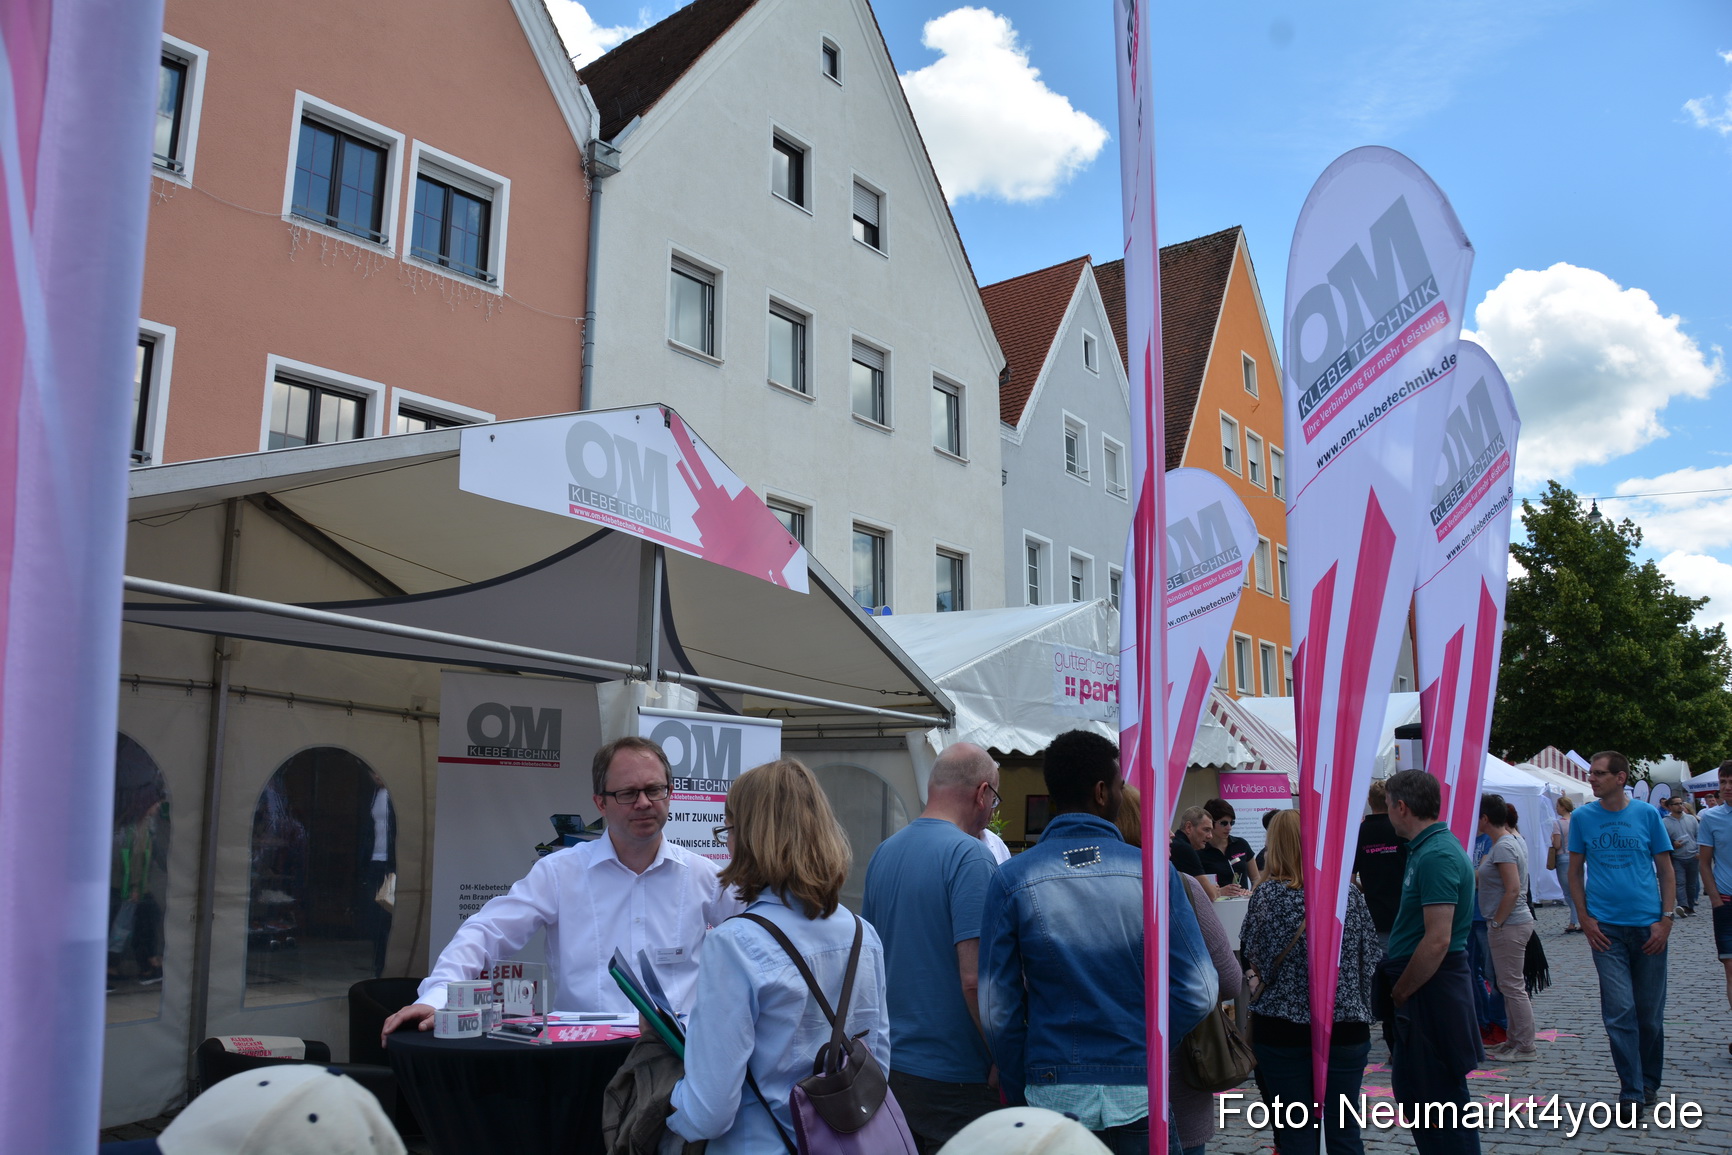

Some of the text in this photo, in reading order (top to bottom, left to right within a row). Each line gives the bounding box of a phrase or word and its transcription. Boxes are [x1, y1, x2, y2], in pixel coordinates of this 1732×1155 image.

[1290, 194, 1434, 392] OM
[1299, 277, 1439, 416] KLEBE TECHNIK
[1306, 309, 1447, 437] Ihre Verbindung für mehr Leistung
[1316, 352, 1457, 469] www.om-klebetechnik.de
[565, 420, 669, 517] OM
[1432, 437, 1505, 523] KLEBE TECHNIK
[1447, 499, 1473, 528] Verbindung
[1489, 457, 1510, 480] Leistung
[571, 486, 671, 532] KLEBE TECHNIK
[574, 508, 645, 534] www.om-klebetechnik.de
[1183, 546, 1241, 581] TECHNIK
[1193, 582, 1202, 592] für
[1203, 577, 1218, 588] mehr
[467, 702, 562, 749] OM
[650, 720, 742, 778] OM
[469, 746, 560, 760] KLEBE TECHNIK
[1223, 784, 1288, 793] Wir bilden aus.
[675, 813, 690, 822] MIT
[692, 813, 725, 822] ZUKUNF
